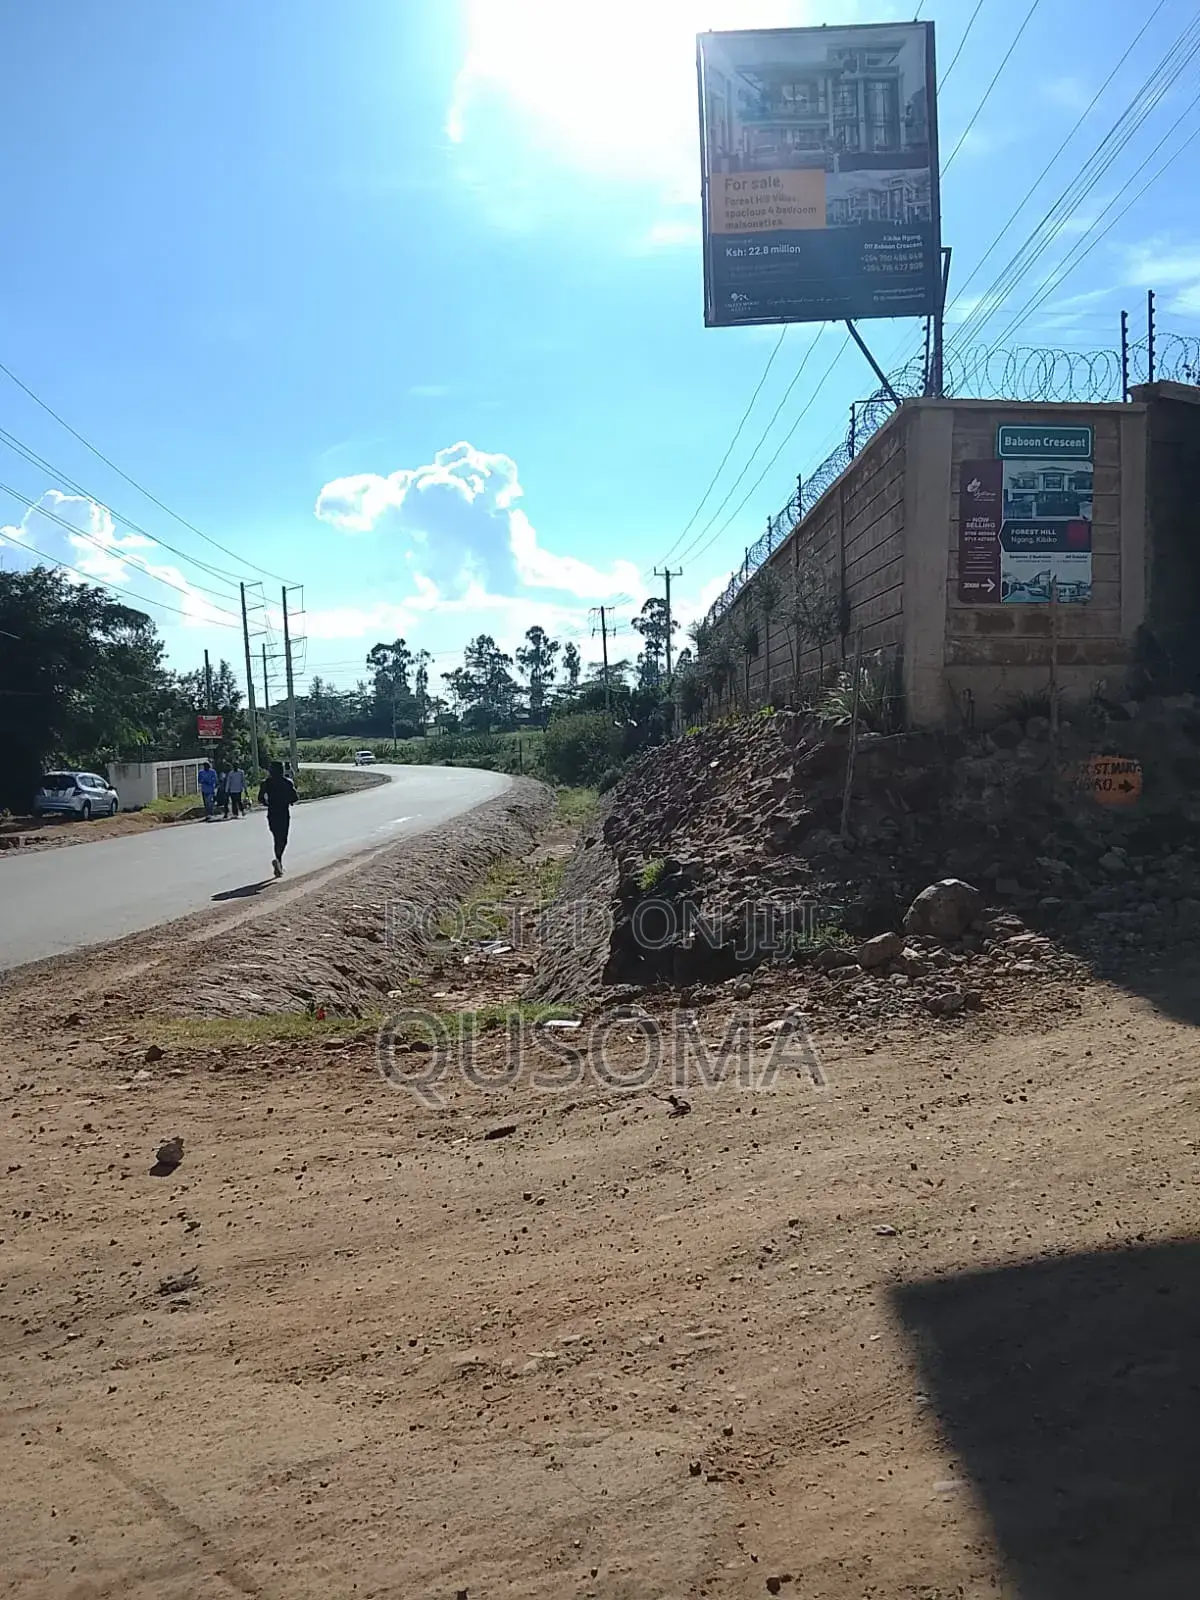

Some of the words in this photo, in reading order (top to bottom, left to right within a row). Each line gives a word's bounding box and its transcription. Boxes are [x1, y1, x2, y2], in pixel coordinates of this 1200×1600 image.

[725, 178, 747, 191] For
[725, 208, 766, 219] spacious
[776, 206, 817, 215] bedroom
[770, 244, 801, 254] million
[1004, 436, 1041, 447] Baboon
[1043, 437, 1086, 448] Crescent
[1036, 536, 1058, 544] Kibiko
